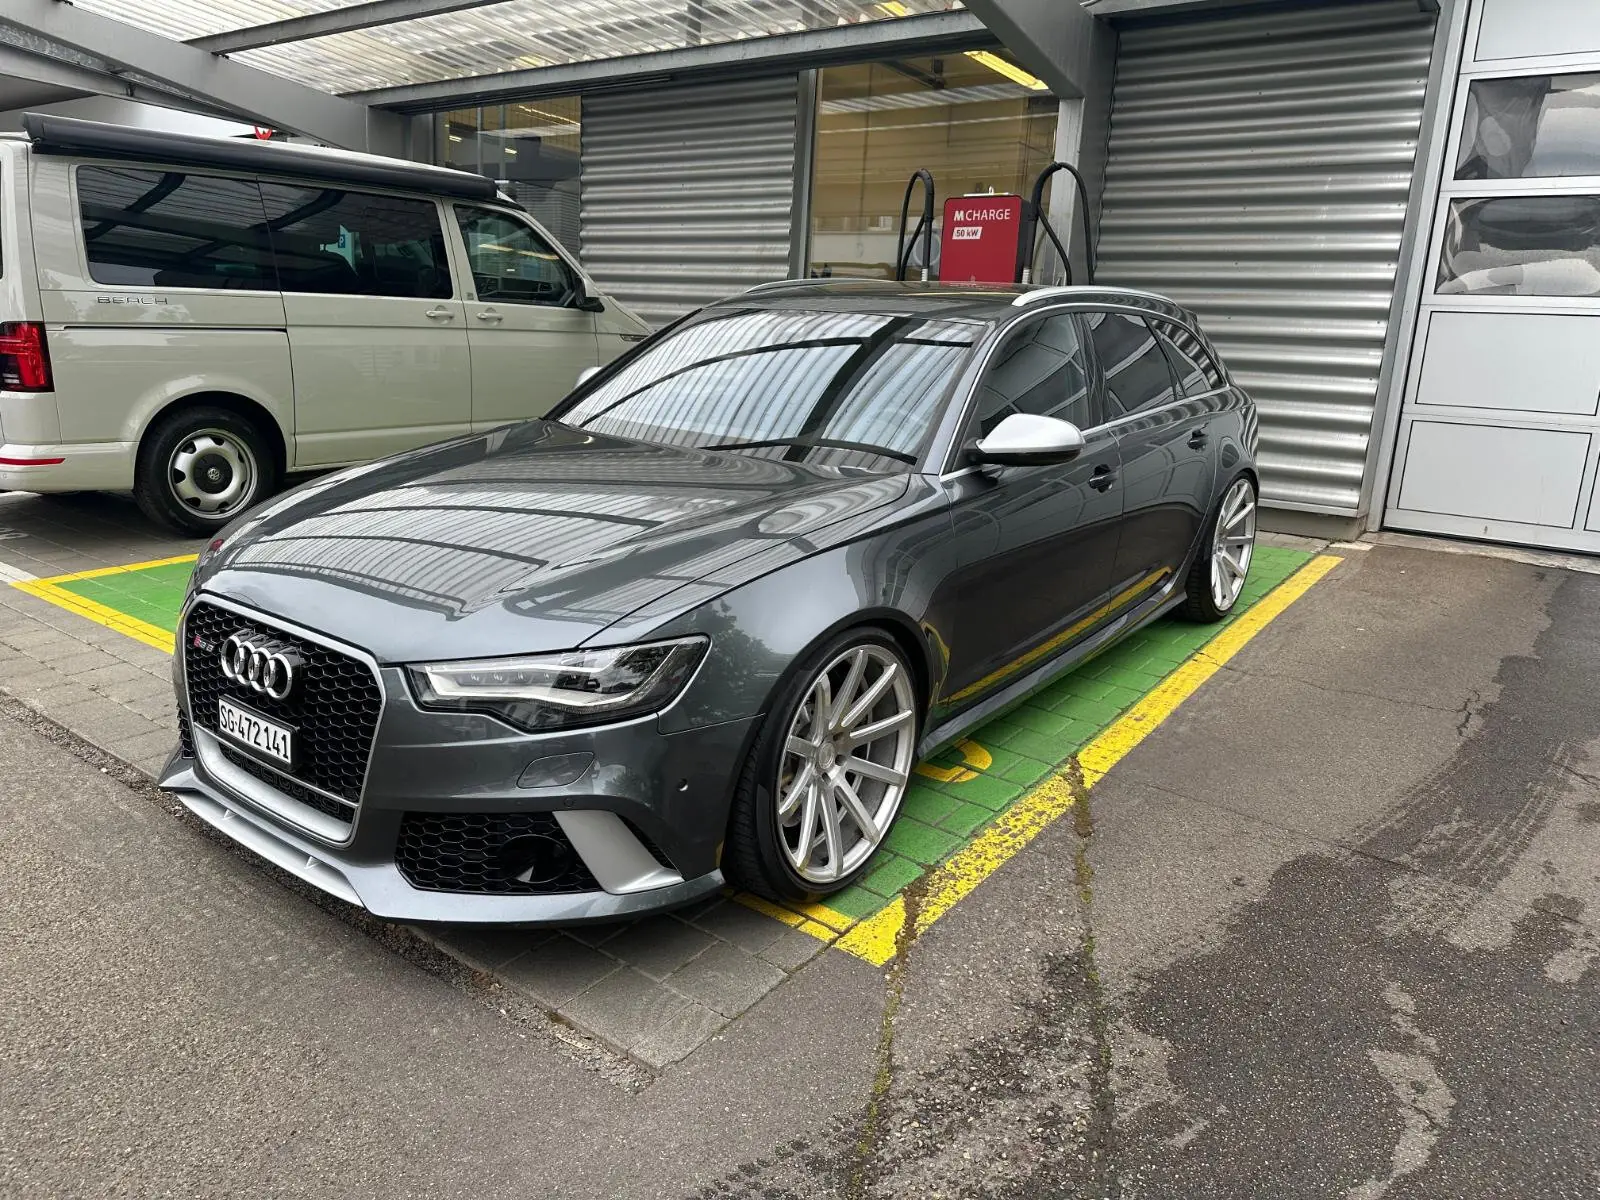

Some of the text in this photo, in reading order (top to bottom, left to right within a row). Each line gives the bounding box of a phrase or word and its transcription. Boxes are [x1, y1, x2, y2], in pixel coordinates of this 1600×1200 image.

[956, 229, 979, 238] 50 kW
[97, 296, 168, 305] BEACH
